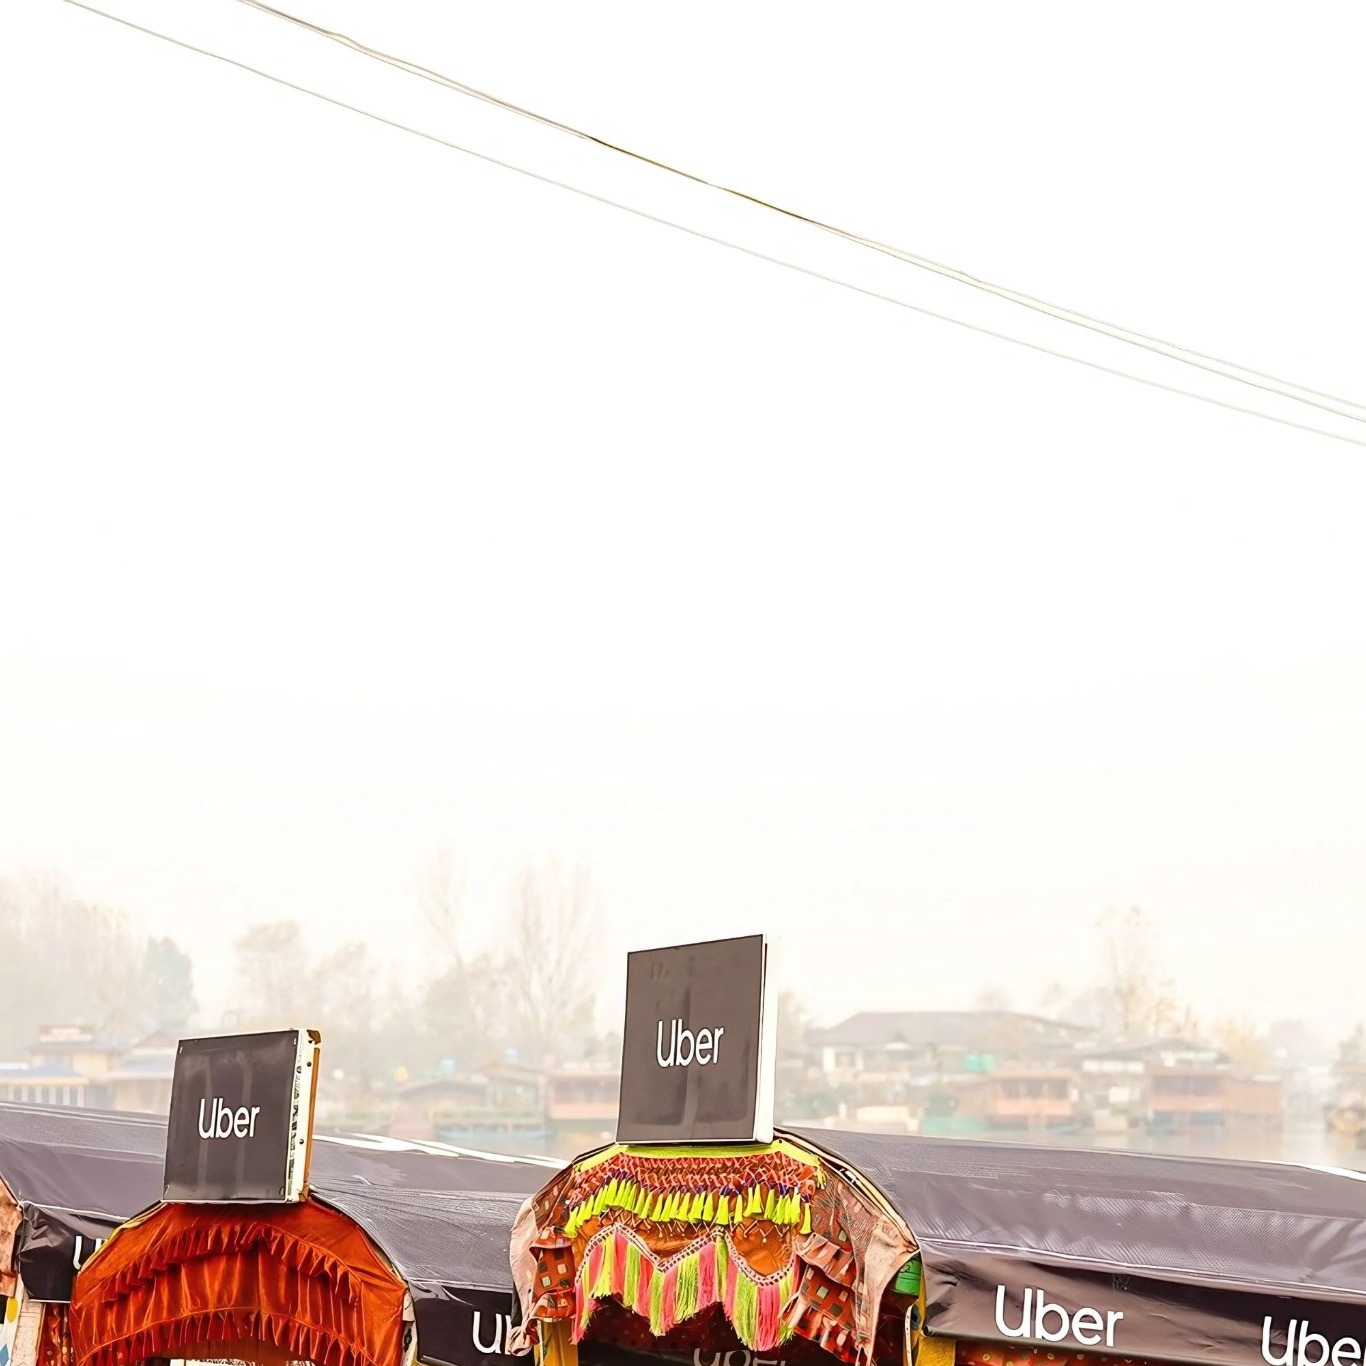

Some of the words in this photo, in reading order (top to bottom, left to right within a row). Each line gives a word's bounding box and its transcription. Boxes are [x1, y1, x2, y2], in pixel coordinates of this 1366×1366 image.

[657, 1018, 724, 1068] Uber
[198, 1097, 261, 1139] Uber
[995, 1284, 1124, 1347] Uber
